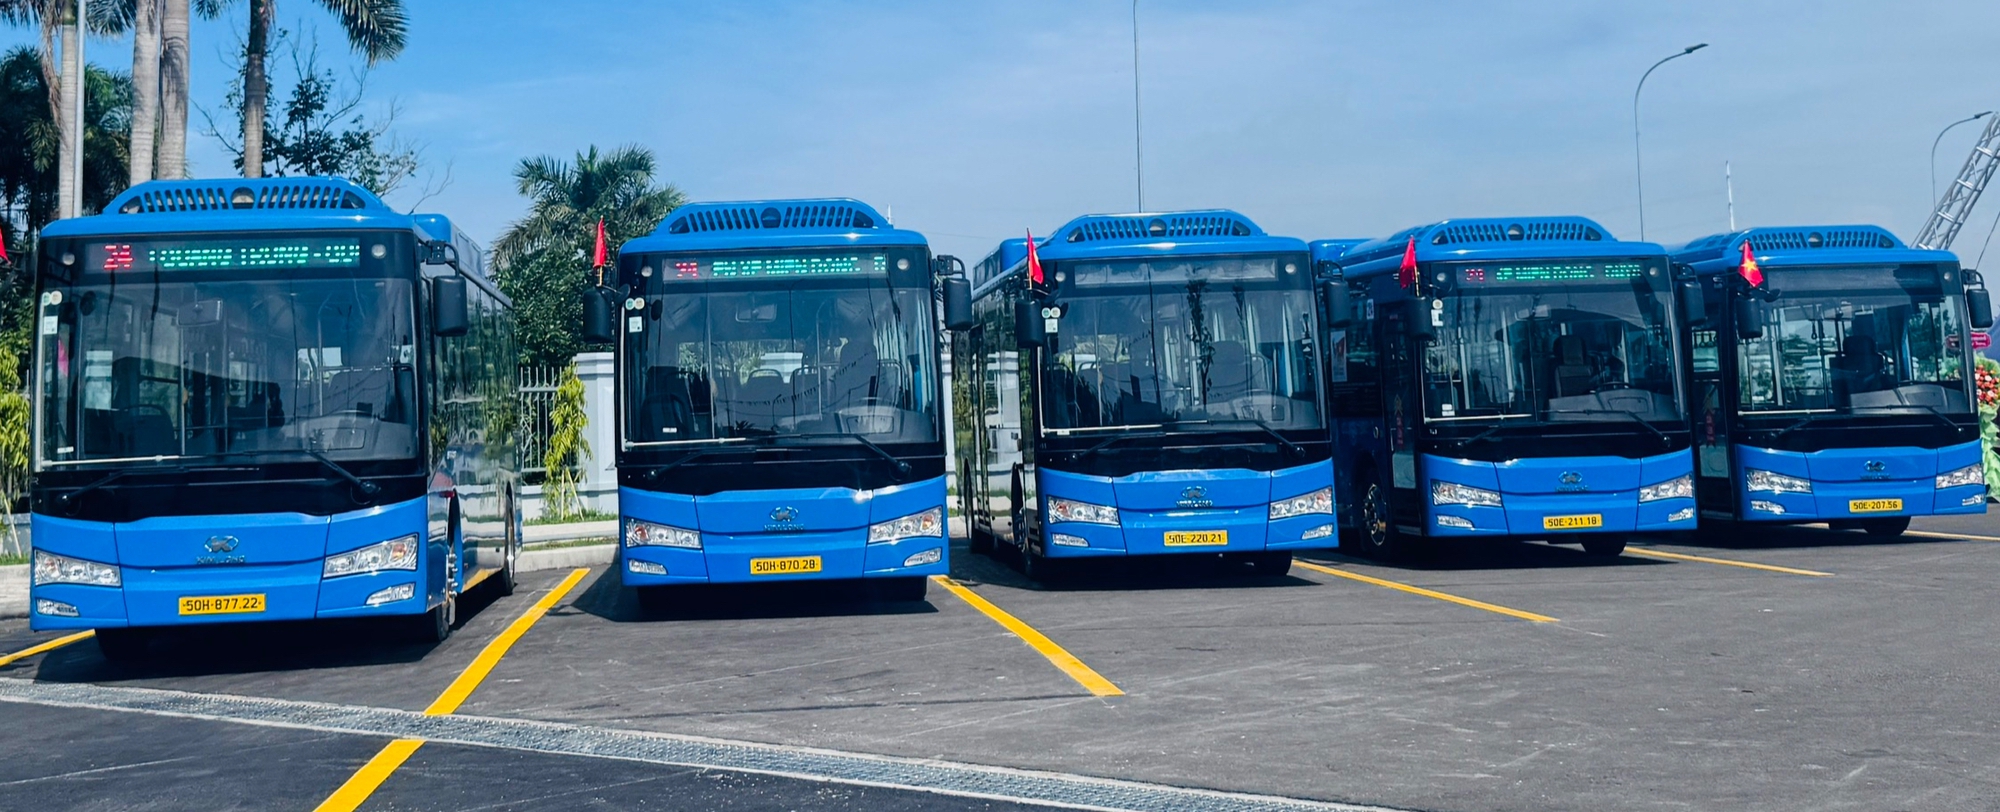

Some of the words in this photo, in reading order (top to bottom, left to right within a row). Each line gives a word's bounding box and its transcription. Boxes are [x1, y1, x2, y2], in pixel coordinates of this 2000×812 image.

[1547, 516, 1597, 527] 50E-211.18
[755, 558, 816, 572] 50H-870.28
[185, 597, 259, 611] 50H-877.22
